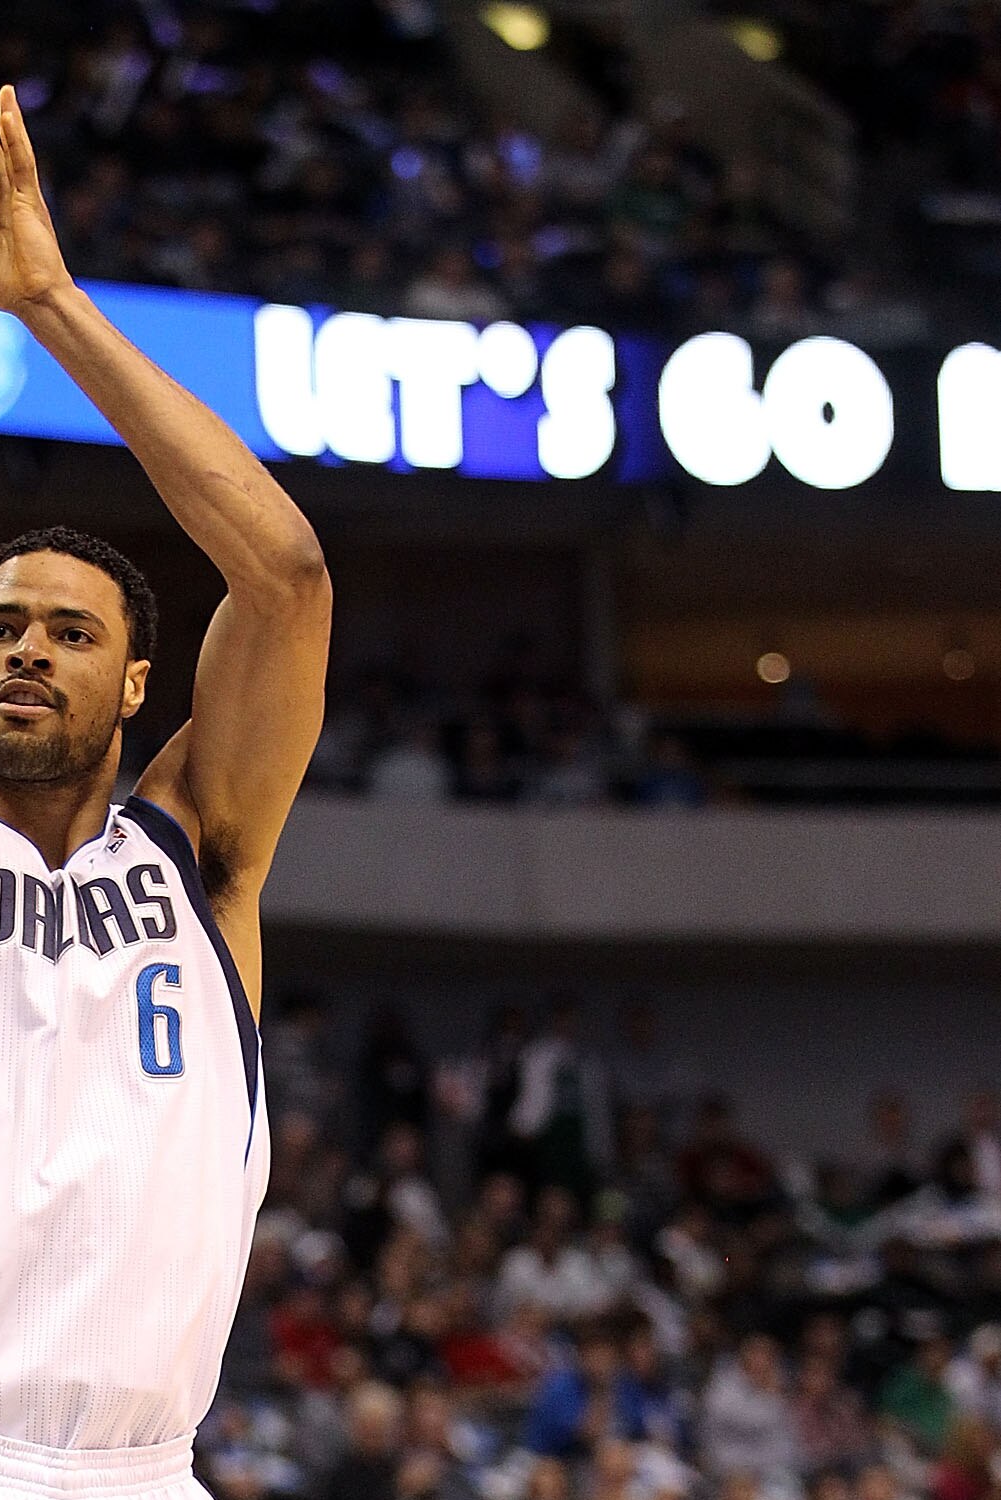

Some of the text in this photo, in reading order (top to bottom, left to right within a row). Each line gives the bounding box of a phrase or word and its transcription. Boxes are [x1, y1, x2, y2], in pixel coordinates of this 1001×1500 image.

[253, 302, 616, 480] LET'S
[657, 330, 895, 490] GO
[134, 962, 187, 1078] 6
